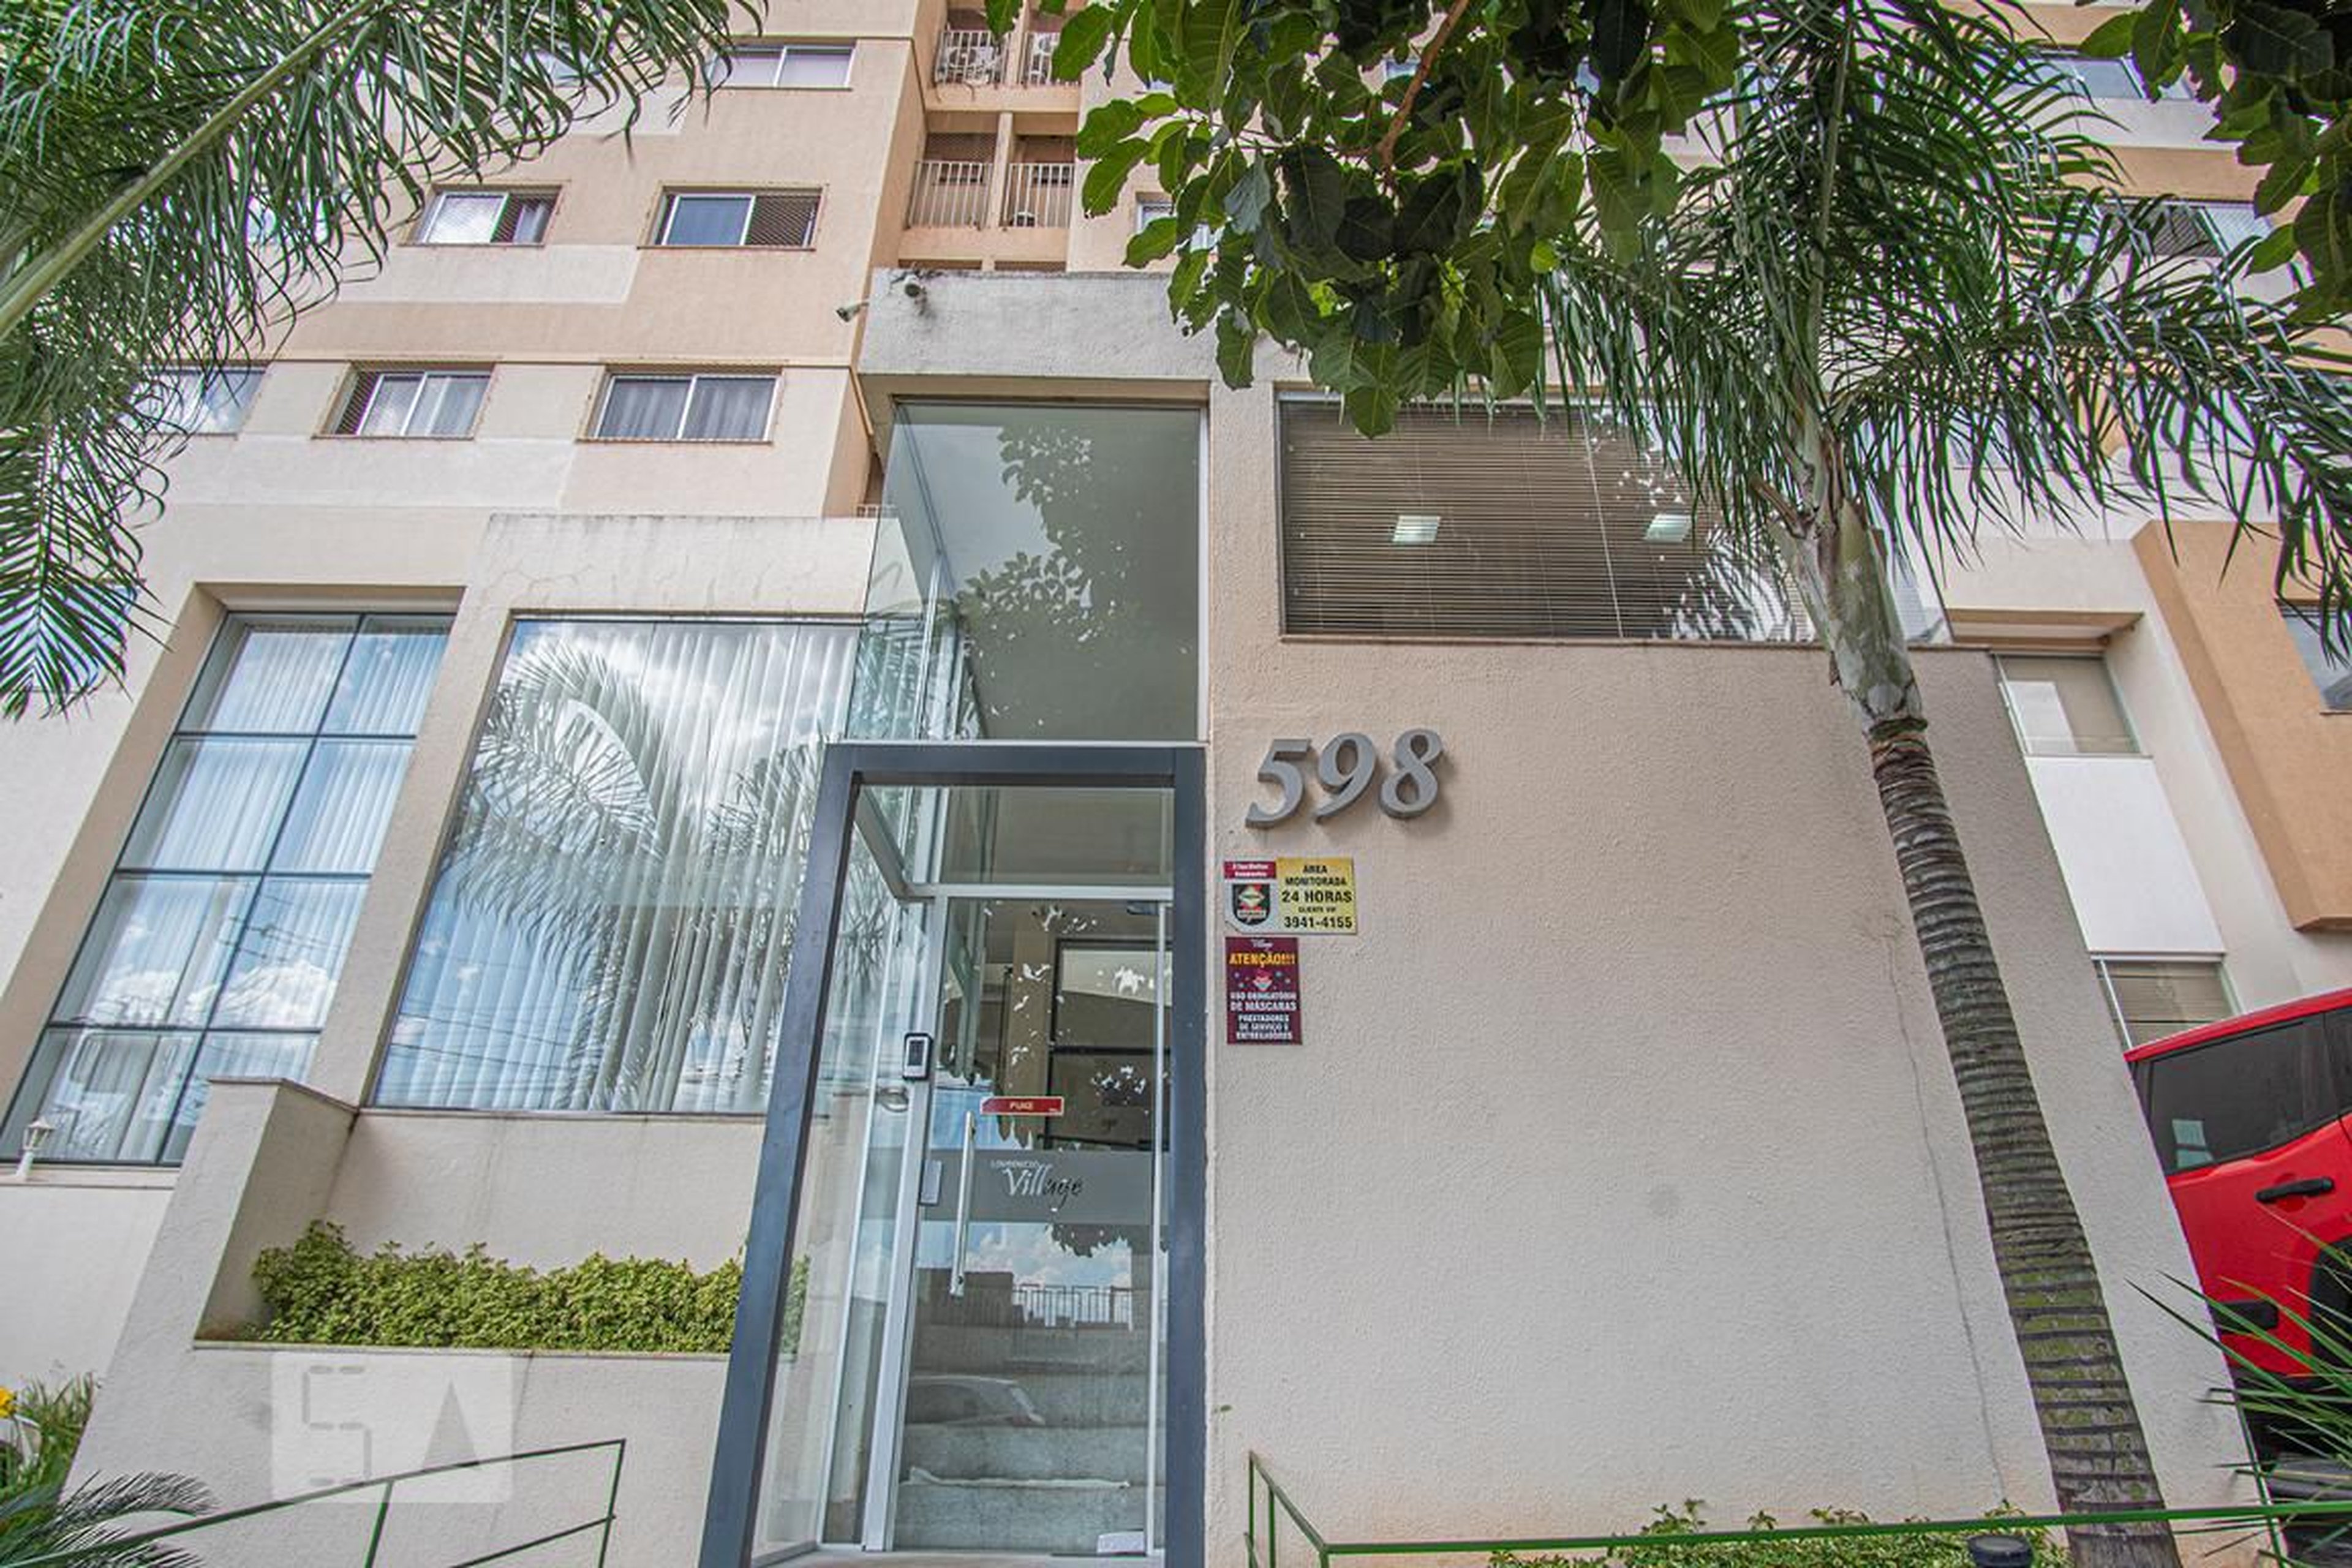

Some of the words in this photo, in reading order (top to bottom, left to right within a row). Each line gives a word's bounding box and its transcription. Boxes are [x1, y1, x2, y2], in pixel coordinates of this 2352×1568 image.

[1245, 728, 1444, 829] 598
[1285, 877, 1347, 886] MONITORADA
[1282, 891, 1298, 902] 24
[1305, 891, 1352, 902] HORAS
[1284, 917, 1352, 928] 3941-4155
[1231, 1001, 1243, 1011] DE
[1002, 1164, 1082, 1208] Village
